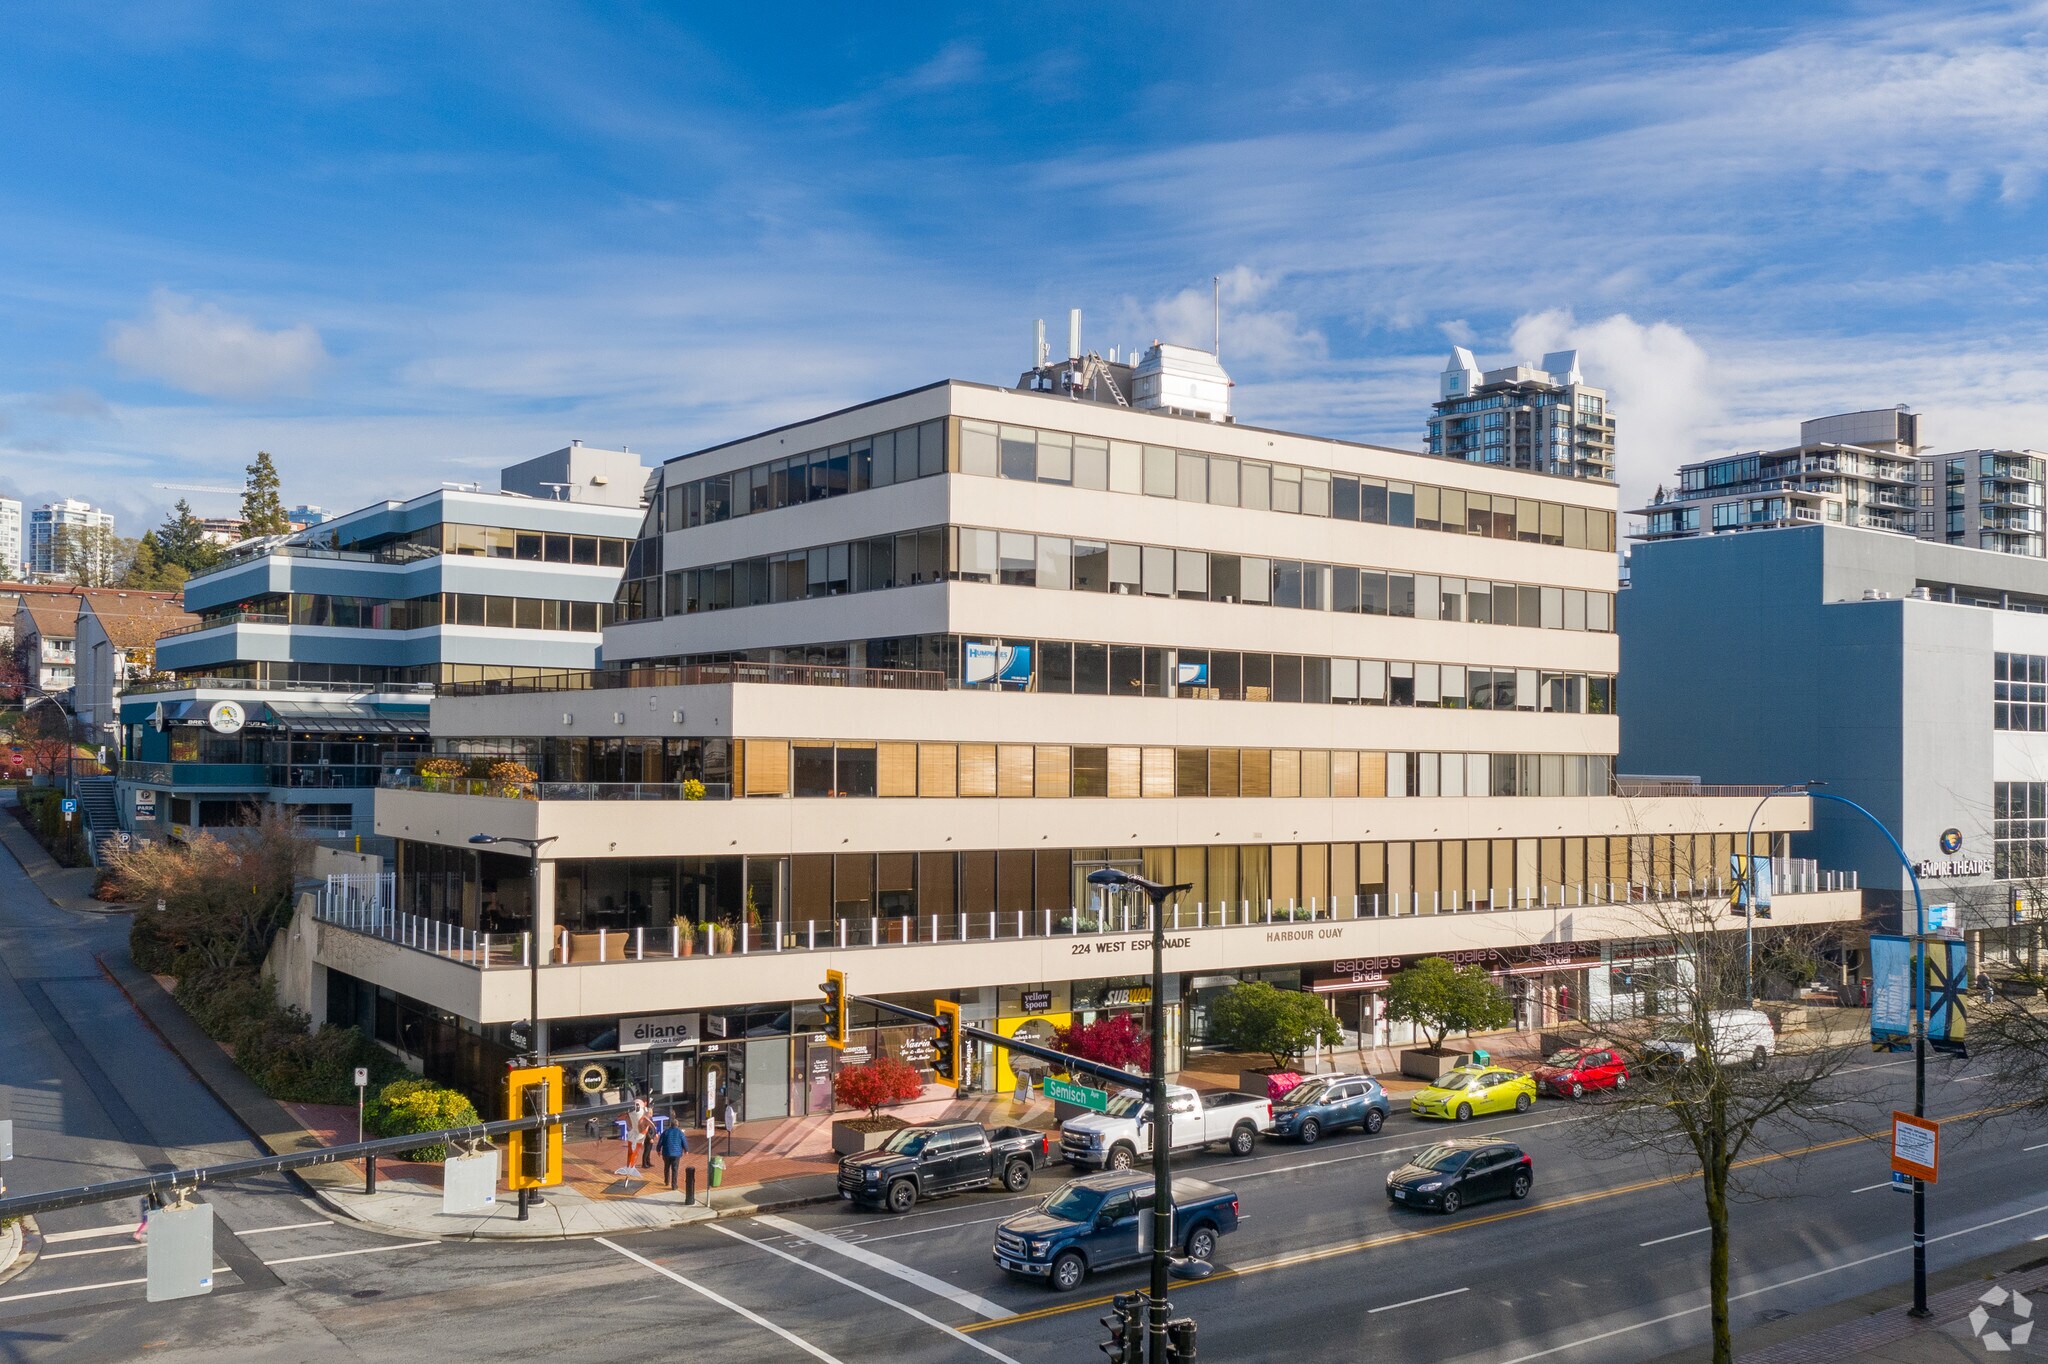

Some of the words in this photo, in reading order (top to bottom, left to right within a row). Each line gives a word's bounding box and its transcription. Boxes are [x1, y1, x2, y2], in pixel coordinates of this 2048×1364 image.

[1921, 861, 1952, 877] EMPIRE
[1953, 859, 1992, 875] THEATRES
[1266, 930, 1314, 942] HARBOUR
[1318, 928, 1344, 939] QUAY
[1071, 944, 1091, 955] 224
[1096, 941, 1126, 953] WEST
[1131, 938, 1191, 951] ESPNADE
[1333, 956, 1401, 973] Isabelle's
[1352, 970, 1383, 982] Bridal
[1025, 992, 1049, 1002] yellow
[1105, 988, 1153, 1005] SUBWAY
[1025, 1001, 1048, 1011] spoon
[634, 1024, 687, 1039] éliane
[814, 1034, 827, 1042] 232
[965, 1040, 973, 1063] yellow
[1050, 1081, 1087, 1104] Semisch
[1090, 1090, 1100, 1099] Ave
